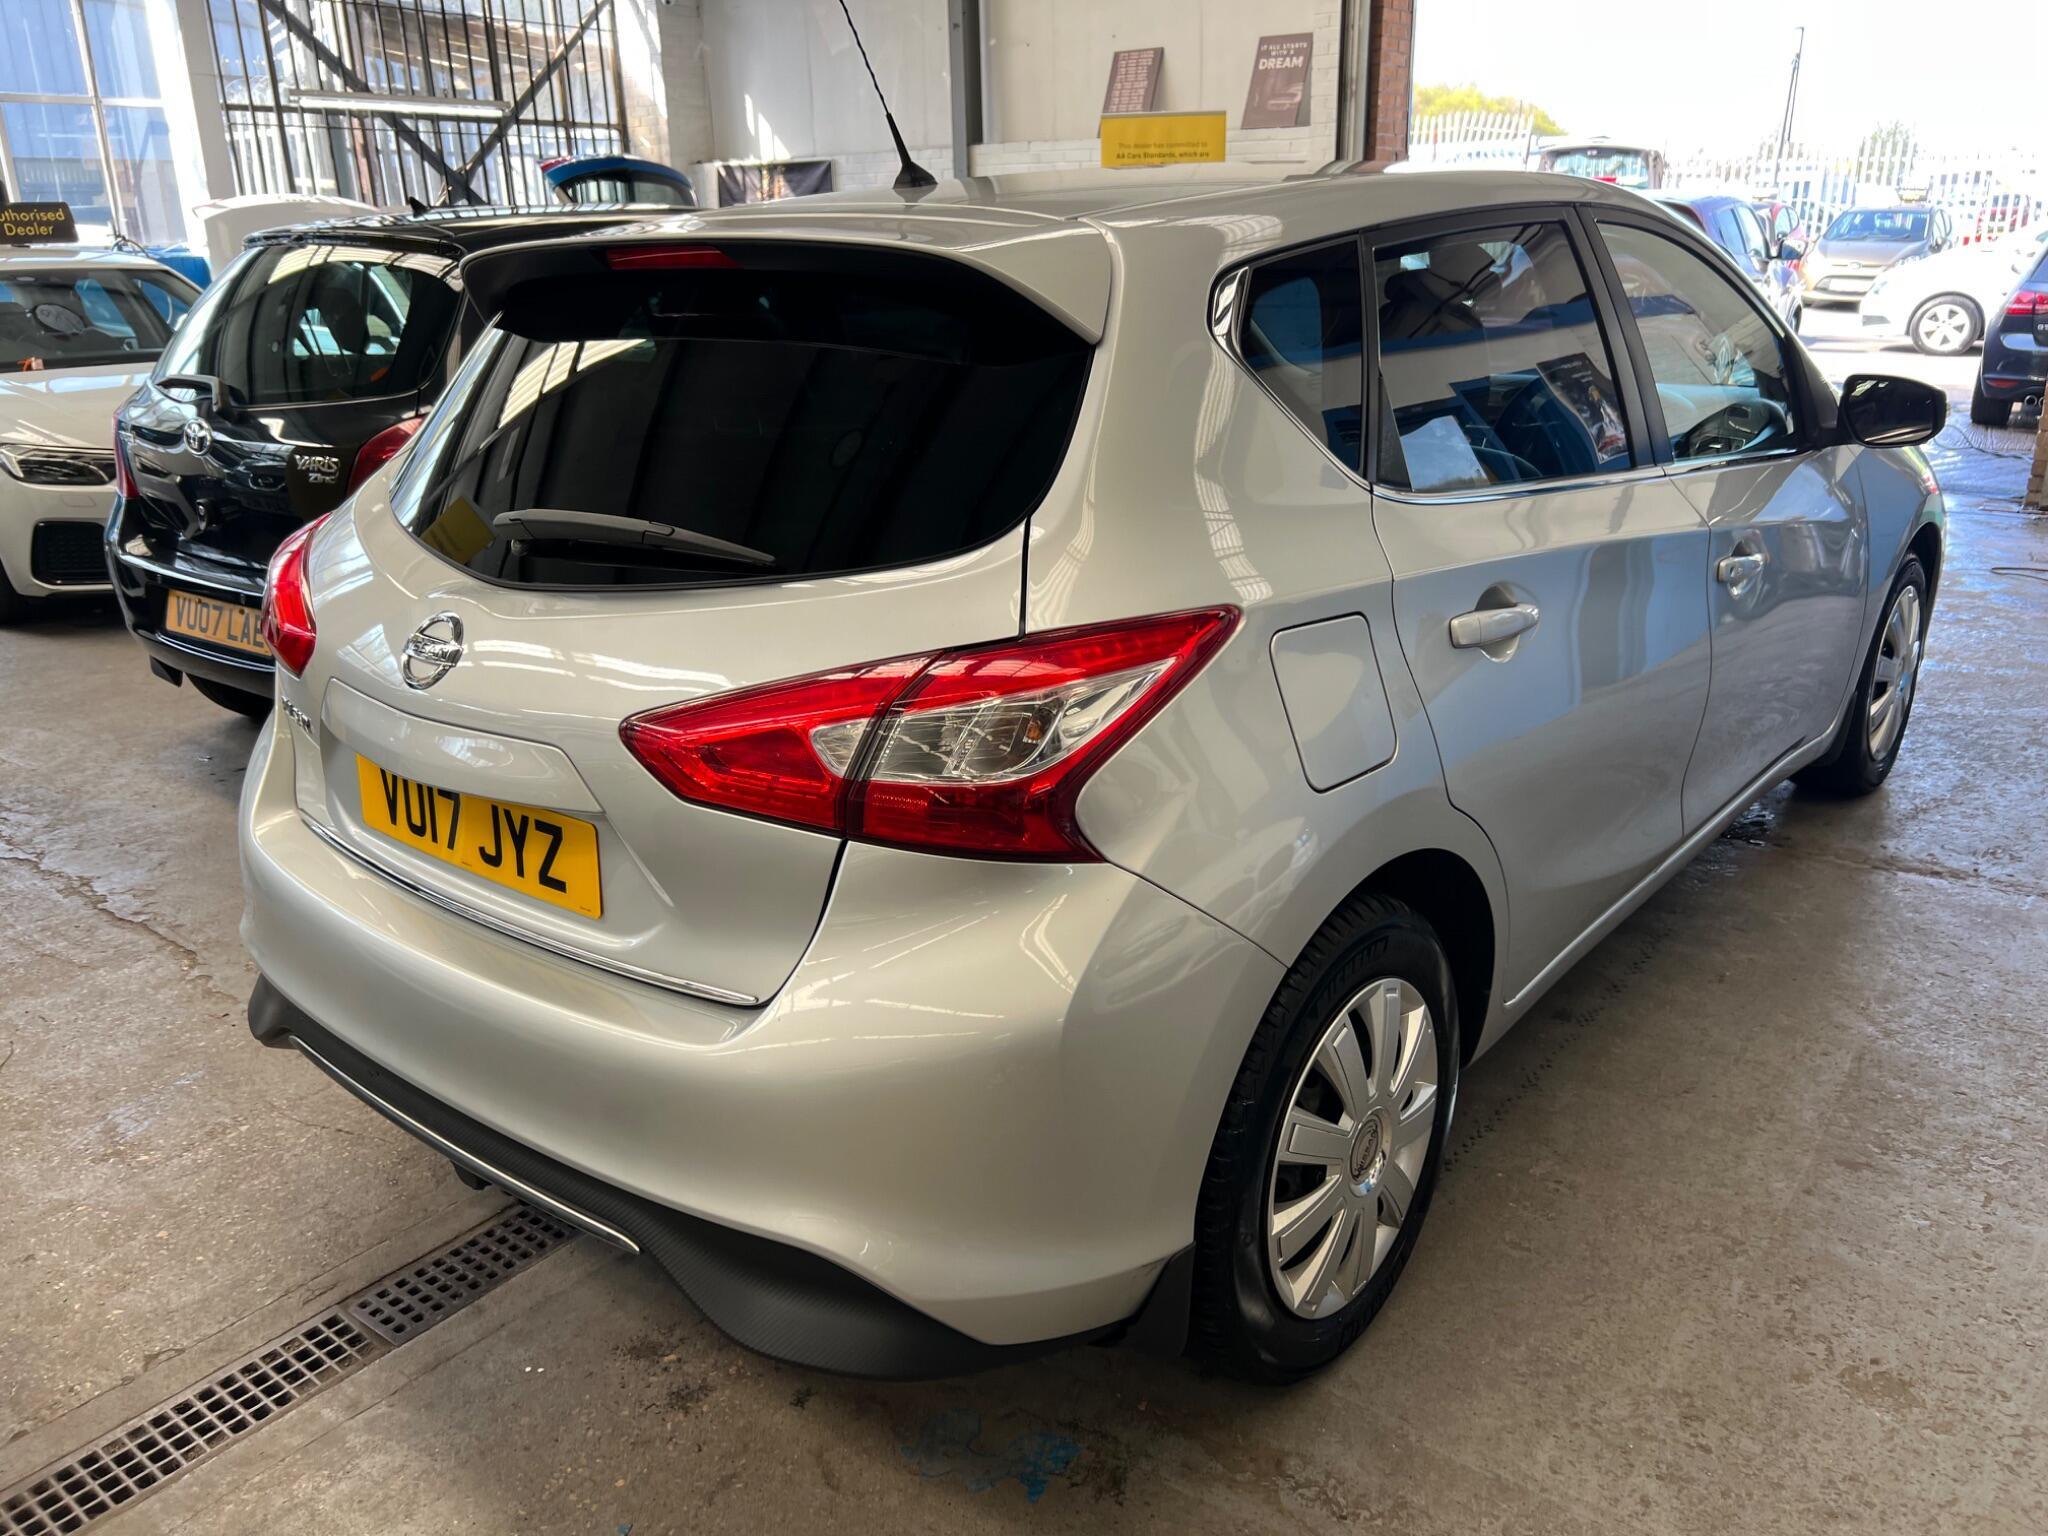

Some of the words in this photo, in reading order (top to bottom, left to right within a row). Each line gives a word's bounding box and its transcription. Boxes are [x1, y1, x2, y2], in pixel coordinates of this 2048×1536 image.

[1258, 56, 1304, 70] DREAM
[4, 222, 54, 236] Dealer
[379, 767, 461, 850] VU17
[478, 804, 567, 894] JYZ
